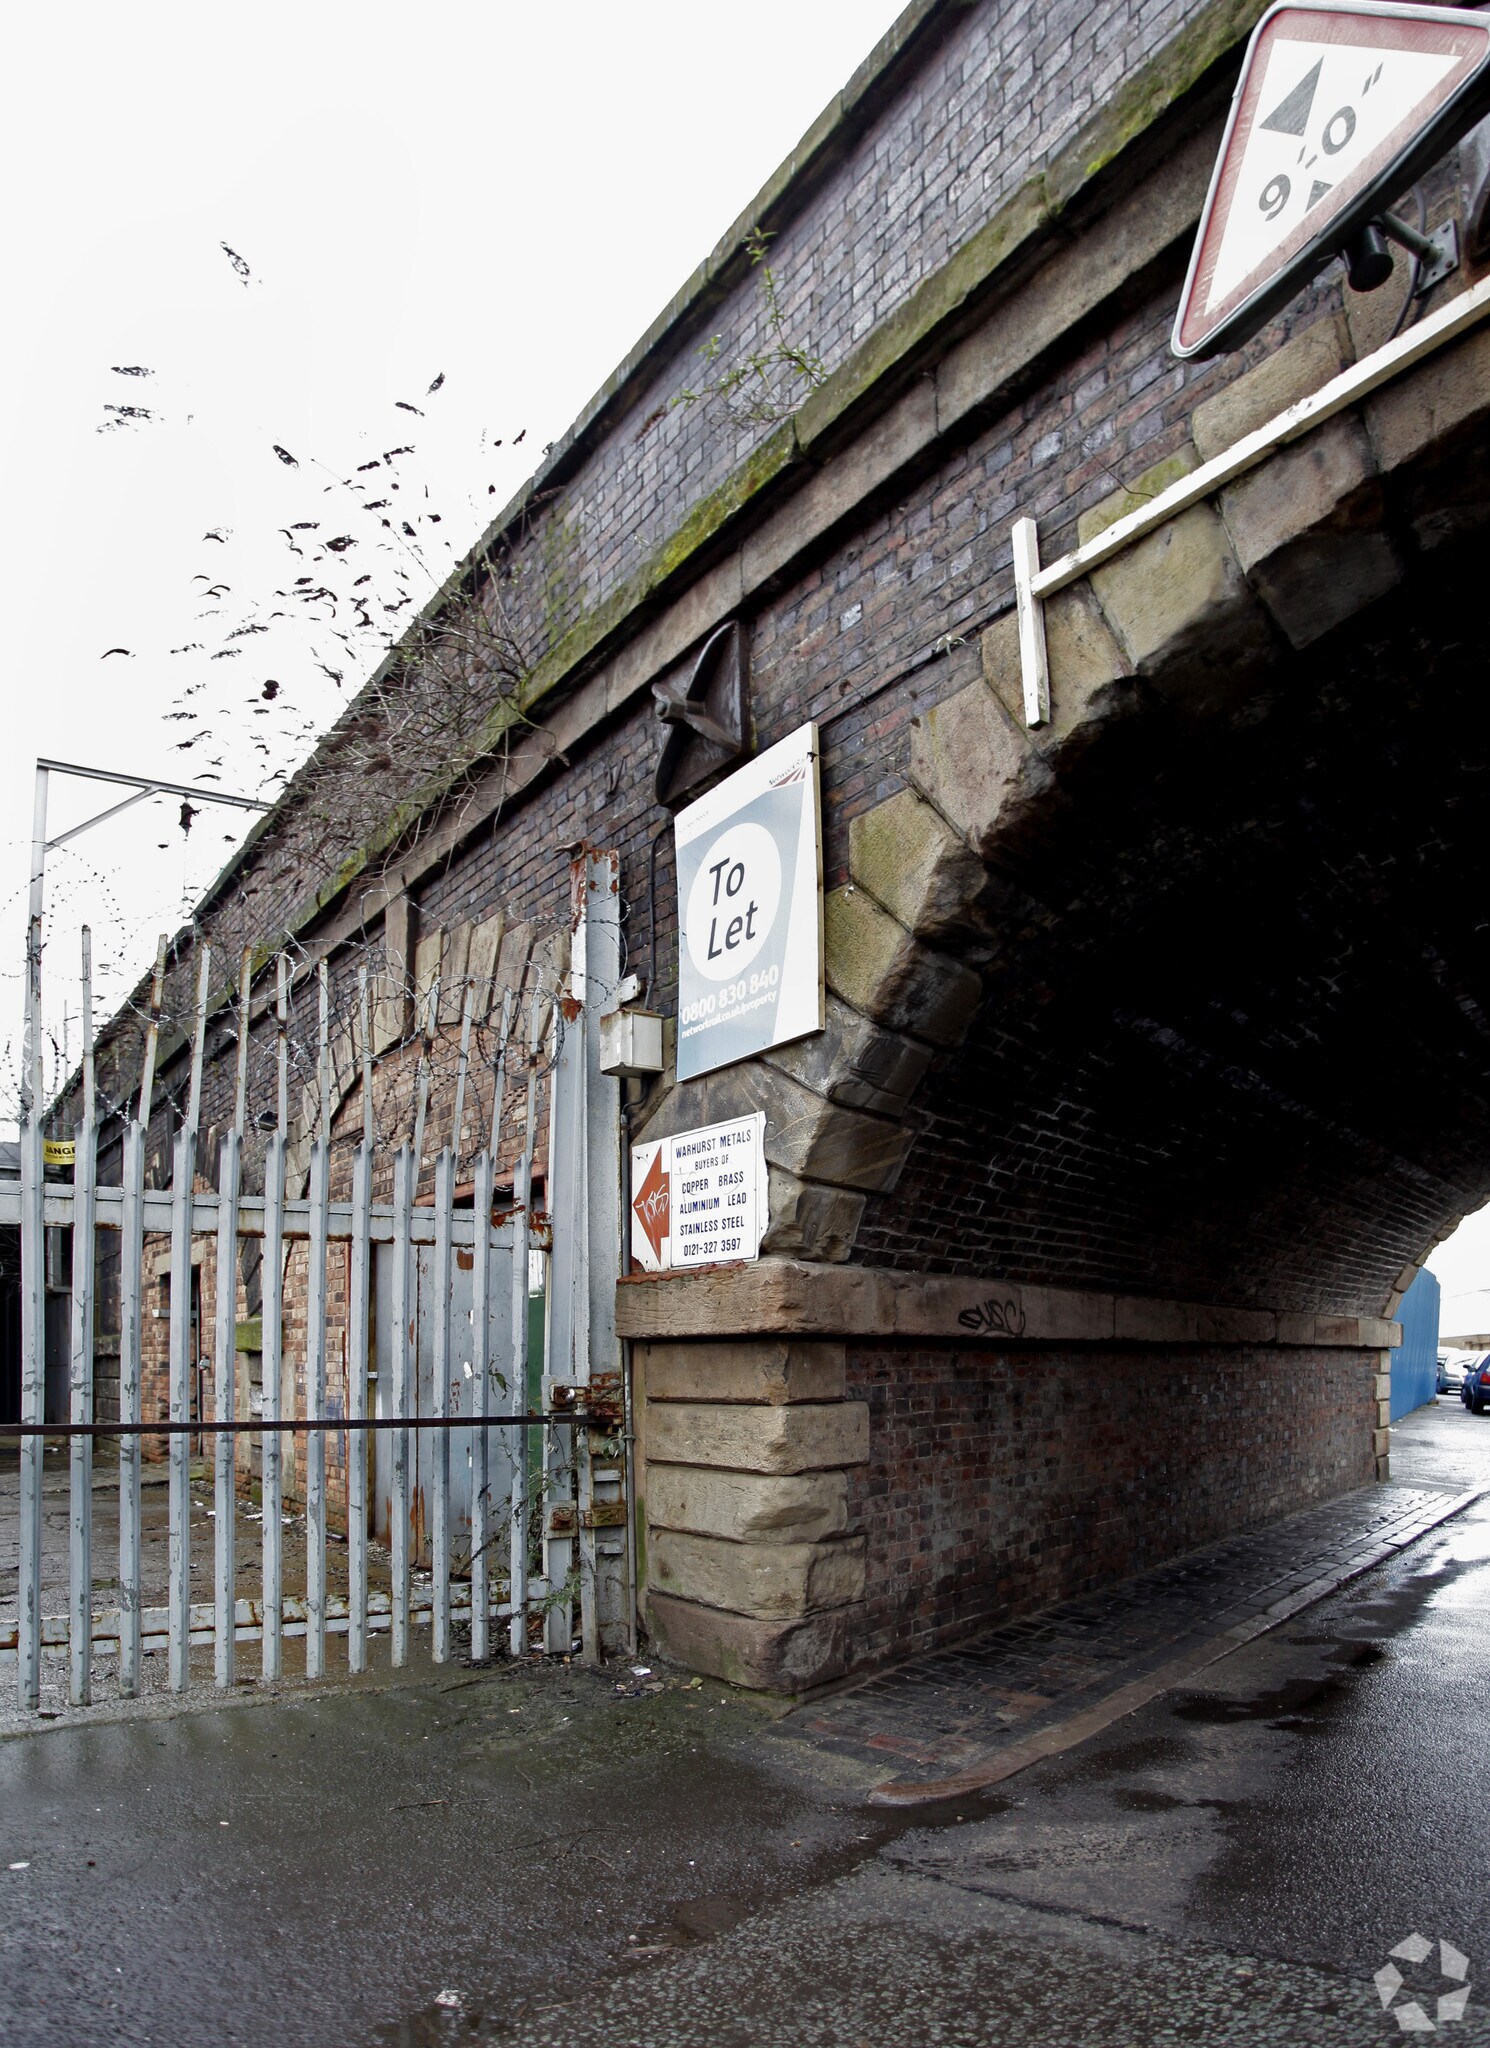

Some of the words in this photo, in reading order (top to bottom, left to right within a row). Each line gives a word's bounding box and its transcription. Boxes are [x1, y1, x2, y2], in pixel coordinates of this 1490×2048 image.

[709, 857, 745, 906] To
[707, 900, 758, 961] Let
[682, 994, 716, 1025] 0800
[719, 980, 747, 1008] 830
[749, 964, 779, 994] 840
[675, 1138, 716, 1158] WARHURST
[719, 1129, 752, 1148] METALS
[695, 1156, 719, 1171] BUYERS
[721, 1153, 729, 1165] OF
[681, 1178, 709, 1194] COPPER
[718, 1171, 744, 1187] BRASS
[679, 1197, 720, 1215] ALUMINIUM
[727, 1192, 747, 1207] LEAD
[679, 1219, 719, 1236] STAINLESS
[721, 1215, 745, 1230] STEEL
[683, 1241, 717, 1256] 0121-327
[720, 1238, 741, 1252] 3597
